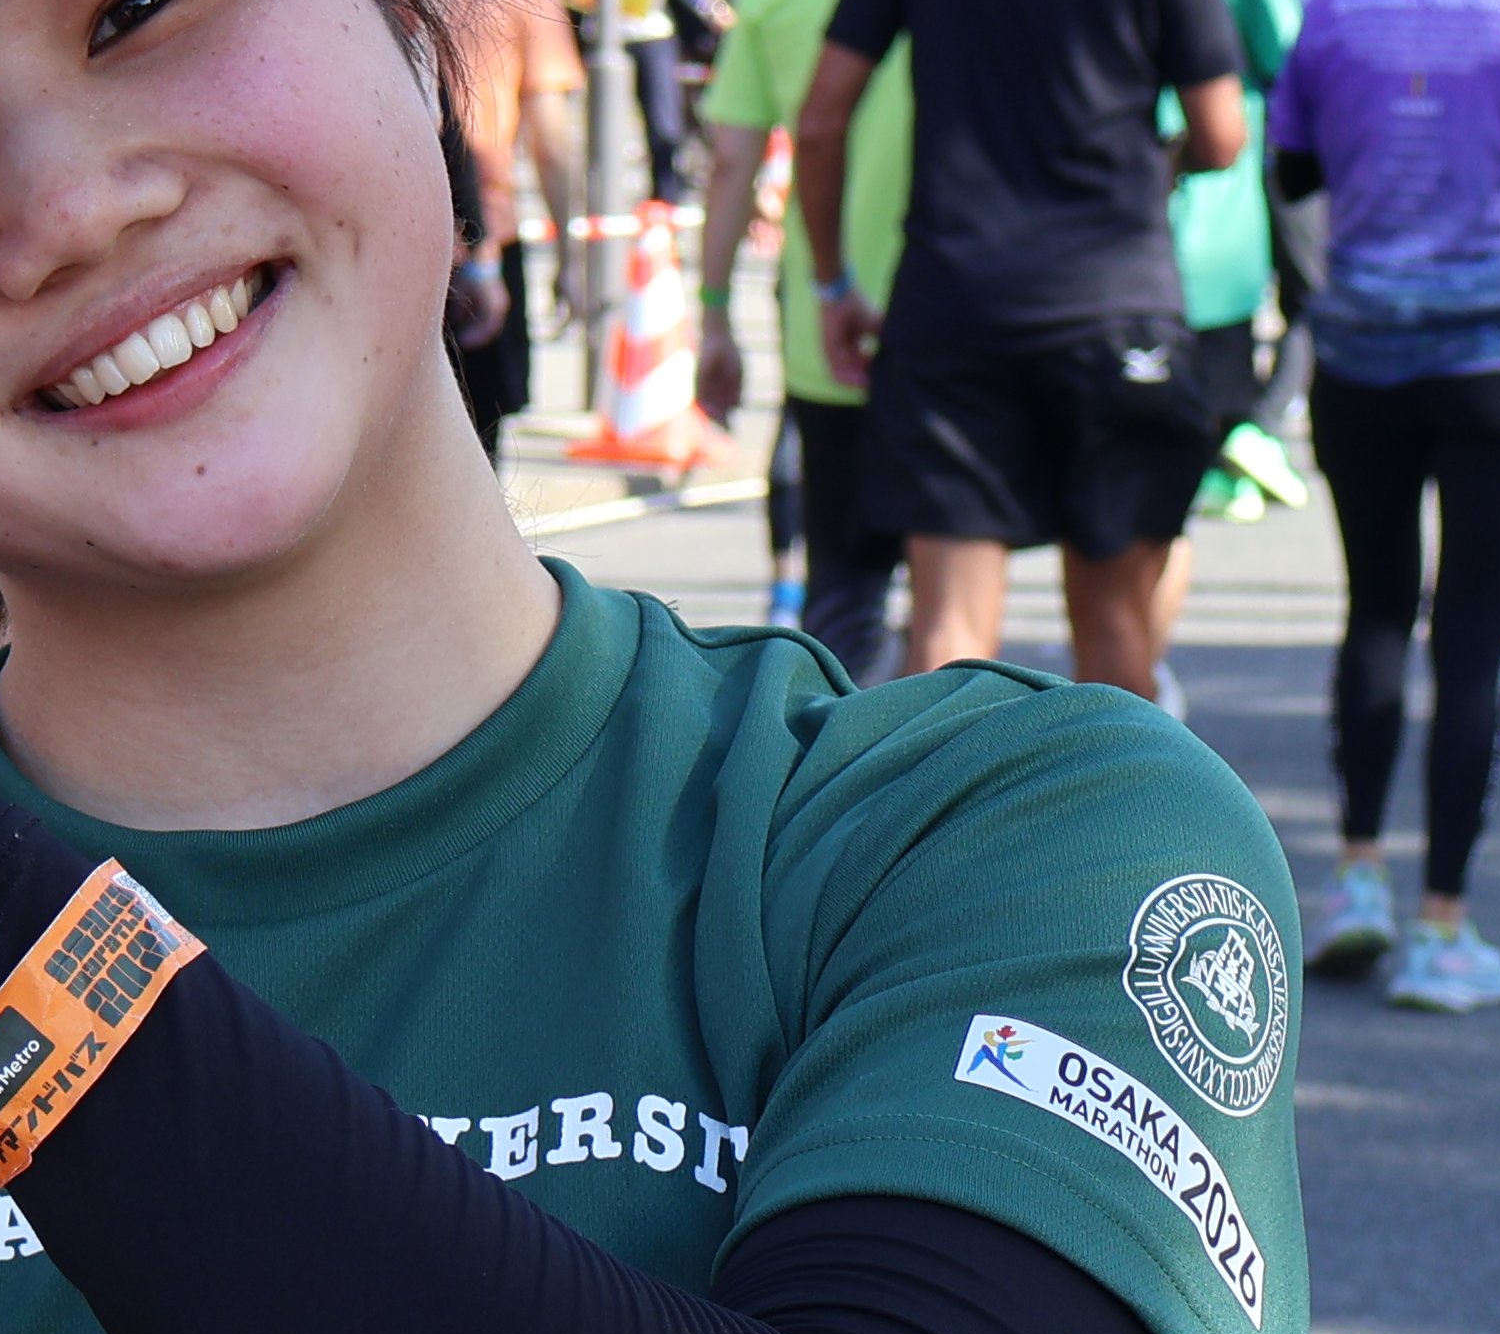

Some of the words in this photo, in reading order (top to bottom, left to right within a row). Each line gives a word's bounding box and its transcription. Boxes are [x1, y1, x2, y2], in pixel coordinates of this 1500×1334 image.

[1049, 1086, 1177, 1191] MARATHON
[1058, 1052, 1181, 1166] OSAKA
[1180, 1152, 1256, 1307] 2026
